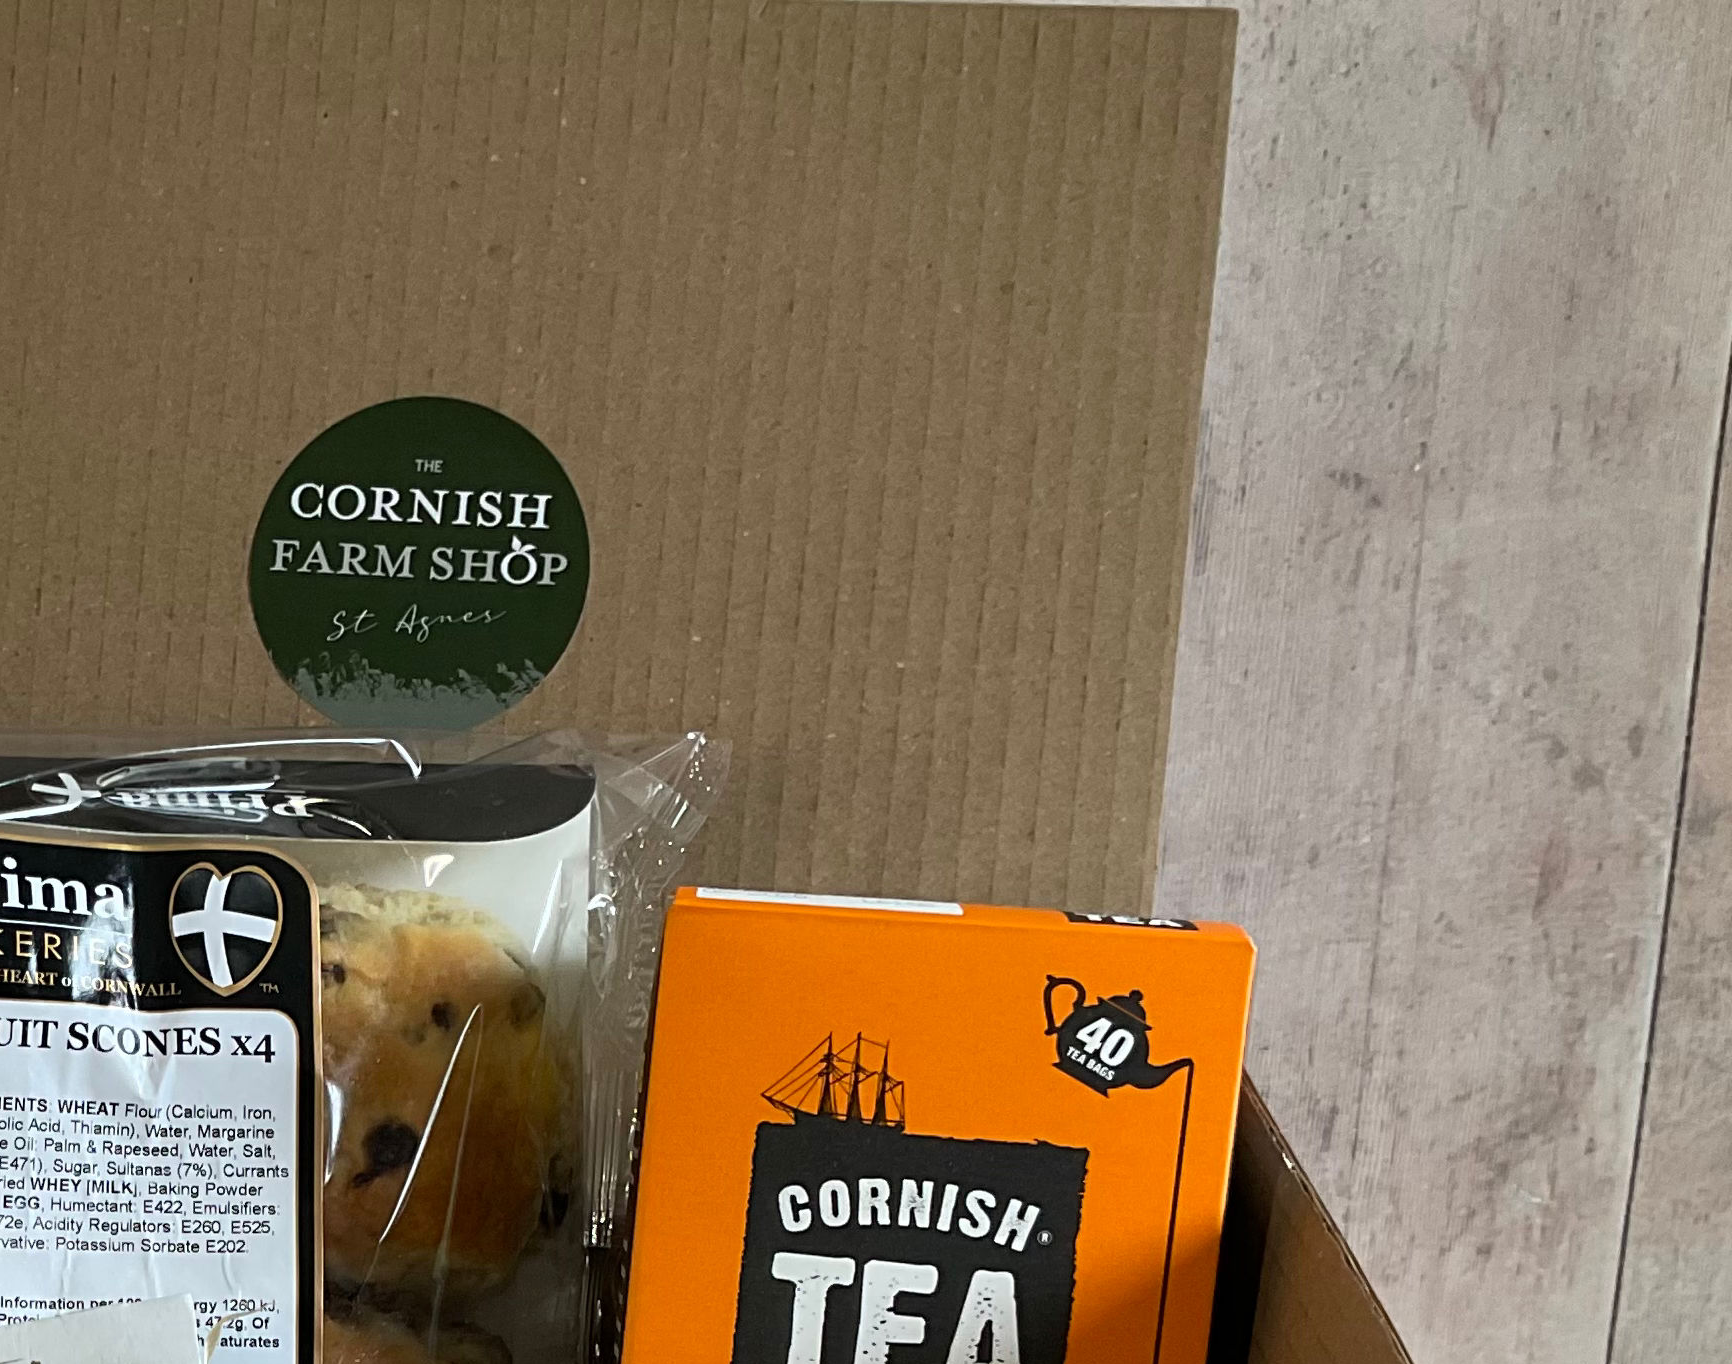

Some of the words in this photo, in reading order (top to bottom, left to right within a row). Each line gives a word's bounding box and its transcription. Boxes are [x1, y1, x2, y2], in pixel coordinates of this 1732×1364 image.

[414, 458, 444, 474] THE
[290, 482, 553, 529] CORNISH
[269, 538, 417, 579] FARM
[429, 536, 568, 586] SHOP
[326, 608, 379, 641] St
[395, 603, 507, 642] Agnes
[81, 976, 182, 998] CORNWALL
[66, 1021, 221, 1058] SCONES
[231, 1033, 276, 1063] x4
[1075, 1017, 1135, 1067] 40
[1066, 1046, 1087, 1066] TEA
[1085, 1058, 1116, 1081] BAGS
[57, 1099, 120, 1117] WHEAT
[124, 1103, 163, 1119] Flour
[165, 1104, 238, 1122] (Calcium,
[243, 1104, 277, 1122] Iron,
[28, 1117, 66, 1136] Acid,
[70, 1119, 140, 1140] Thiamin),
[145, 1123, 192, 1140] Water,
[197, 1124, 276, 1142] Margarine
[44, 1137, 81, 1153] Palm
[86, 1139, 98, 1155] &
[102, 1140, 183, 1160] Rapeseed,
[188, 1142, 238, 1160] Water,
[242, 1143, 276, 1161] Salt,
[52, 1158, 101, 1178] Sugar,
[106, 1161, 172, 1177] Sultanas
[176, 1162, 217, 1181] (7%),
[223, 1163, 290, 1179] Currants
[30, 1176, 82, 1193] WHEY
[147, 1181, 200, 1199] Baking
[205, 1182, 264, 1197] Powder
[2, 1194, 45, 1213] EGG,
[49, 1196, 137, 1214] Humectant:
[142, 1199, 188, 1217] E422,
[192, 1200, 281, 1216] Emulsifiers:
[777, 1177, 1040, 1252] CORNISH
[32, 1215, 84, 1235] Acidity
[88, 1217, 176, 1236] Regulators:
[180, 1219, 225, 1237] E260,
[230, 1220, 275, 1237] E525,
[55, 1236, 135, 1253] Potassium
[140, 1238, 200, 1254] Sorbate
[0, 1295, 85, 1311] Information
[222, 1298, 256, 1312] 1260
[251, 1316, 271, 1330] Of
[219, 1335, 280, 1348] aturates
